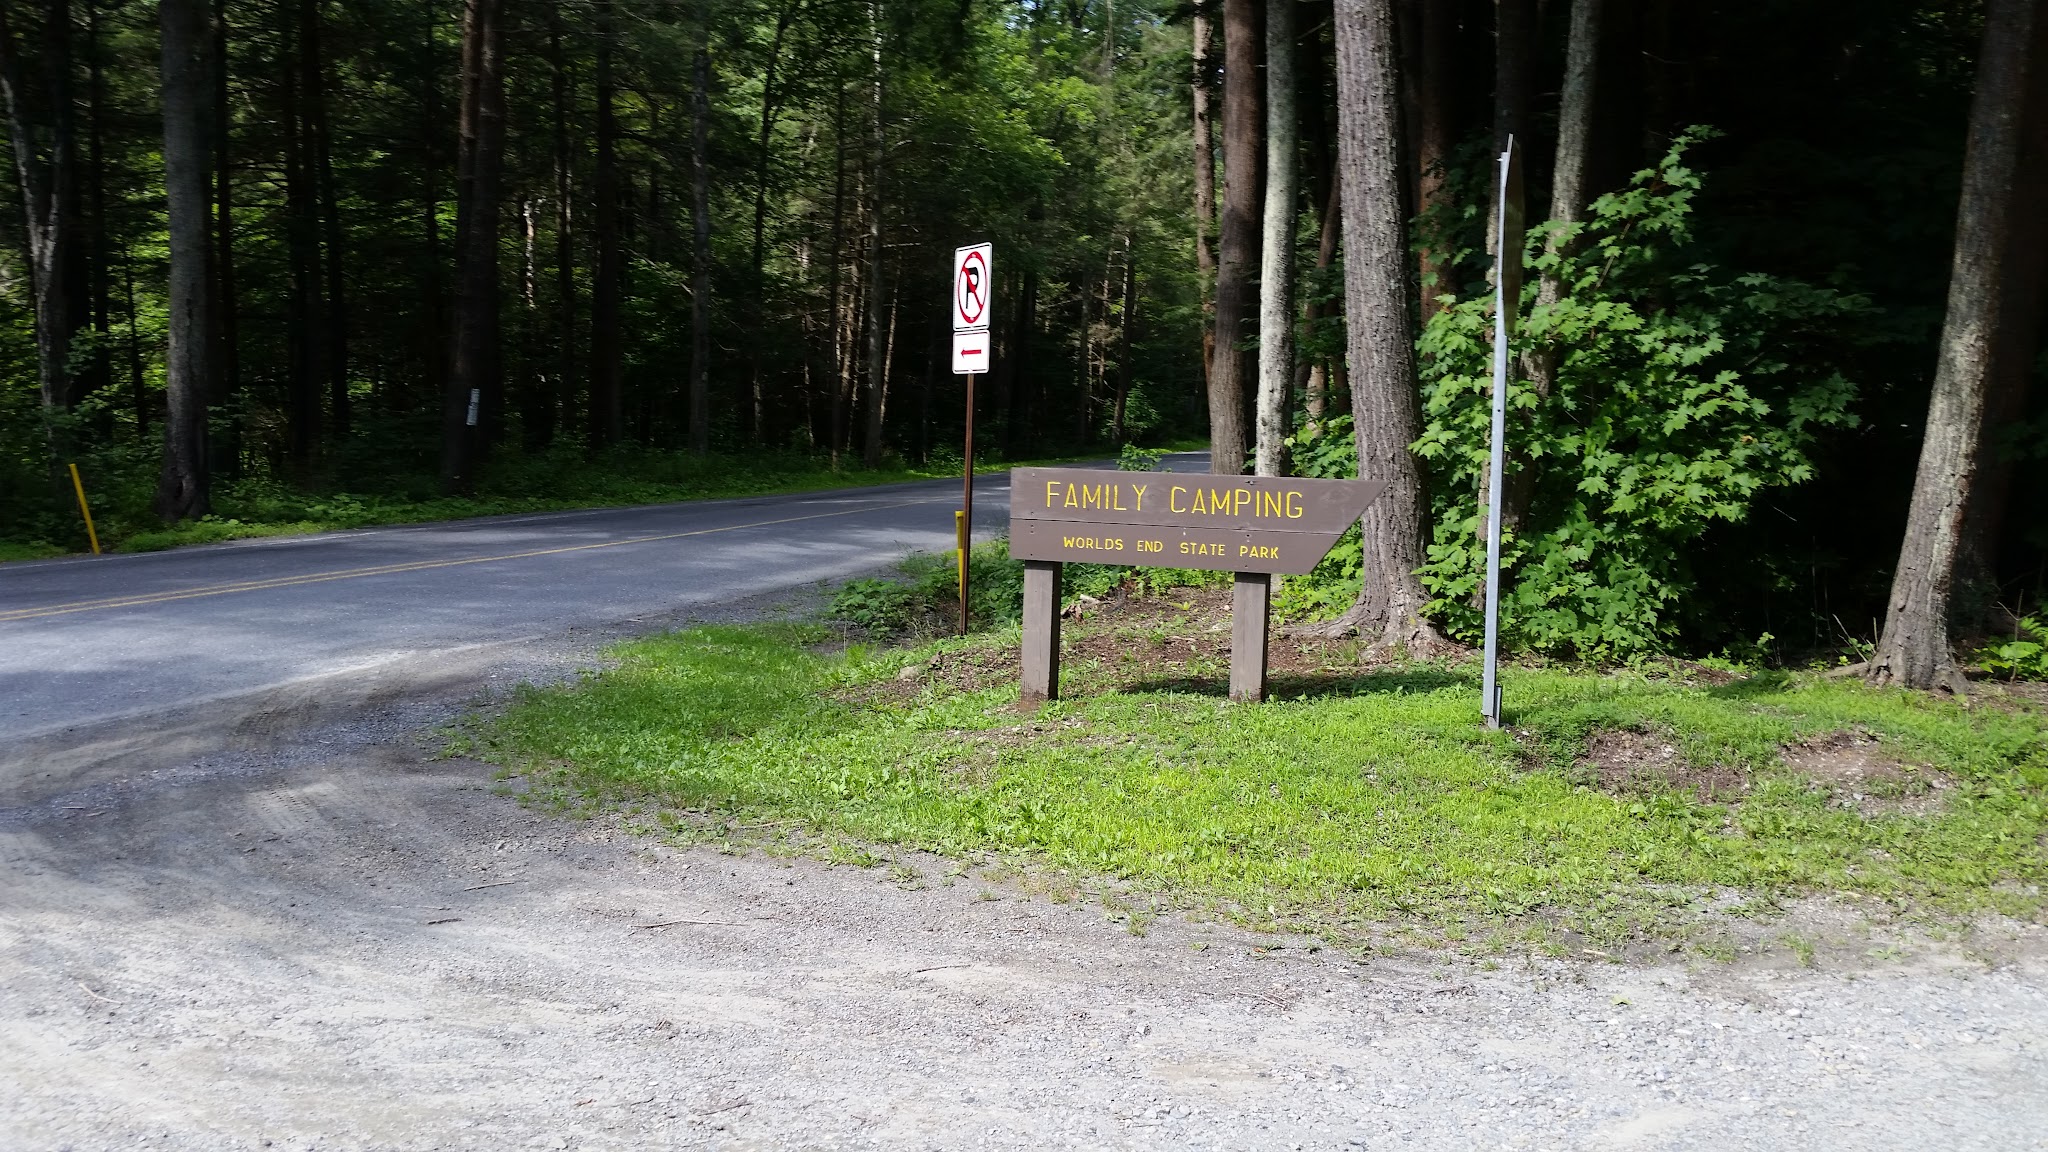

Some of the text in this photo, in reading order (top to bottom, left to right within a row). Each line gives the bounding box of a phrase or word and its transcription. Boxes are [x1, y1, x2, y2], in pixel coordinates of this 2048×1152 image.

[1046, 481, 1303, 518] FAMILY CAMPING
[1063, 537, 1279, 558] WORLDS END STATE PARK
